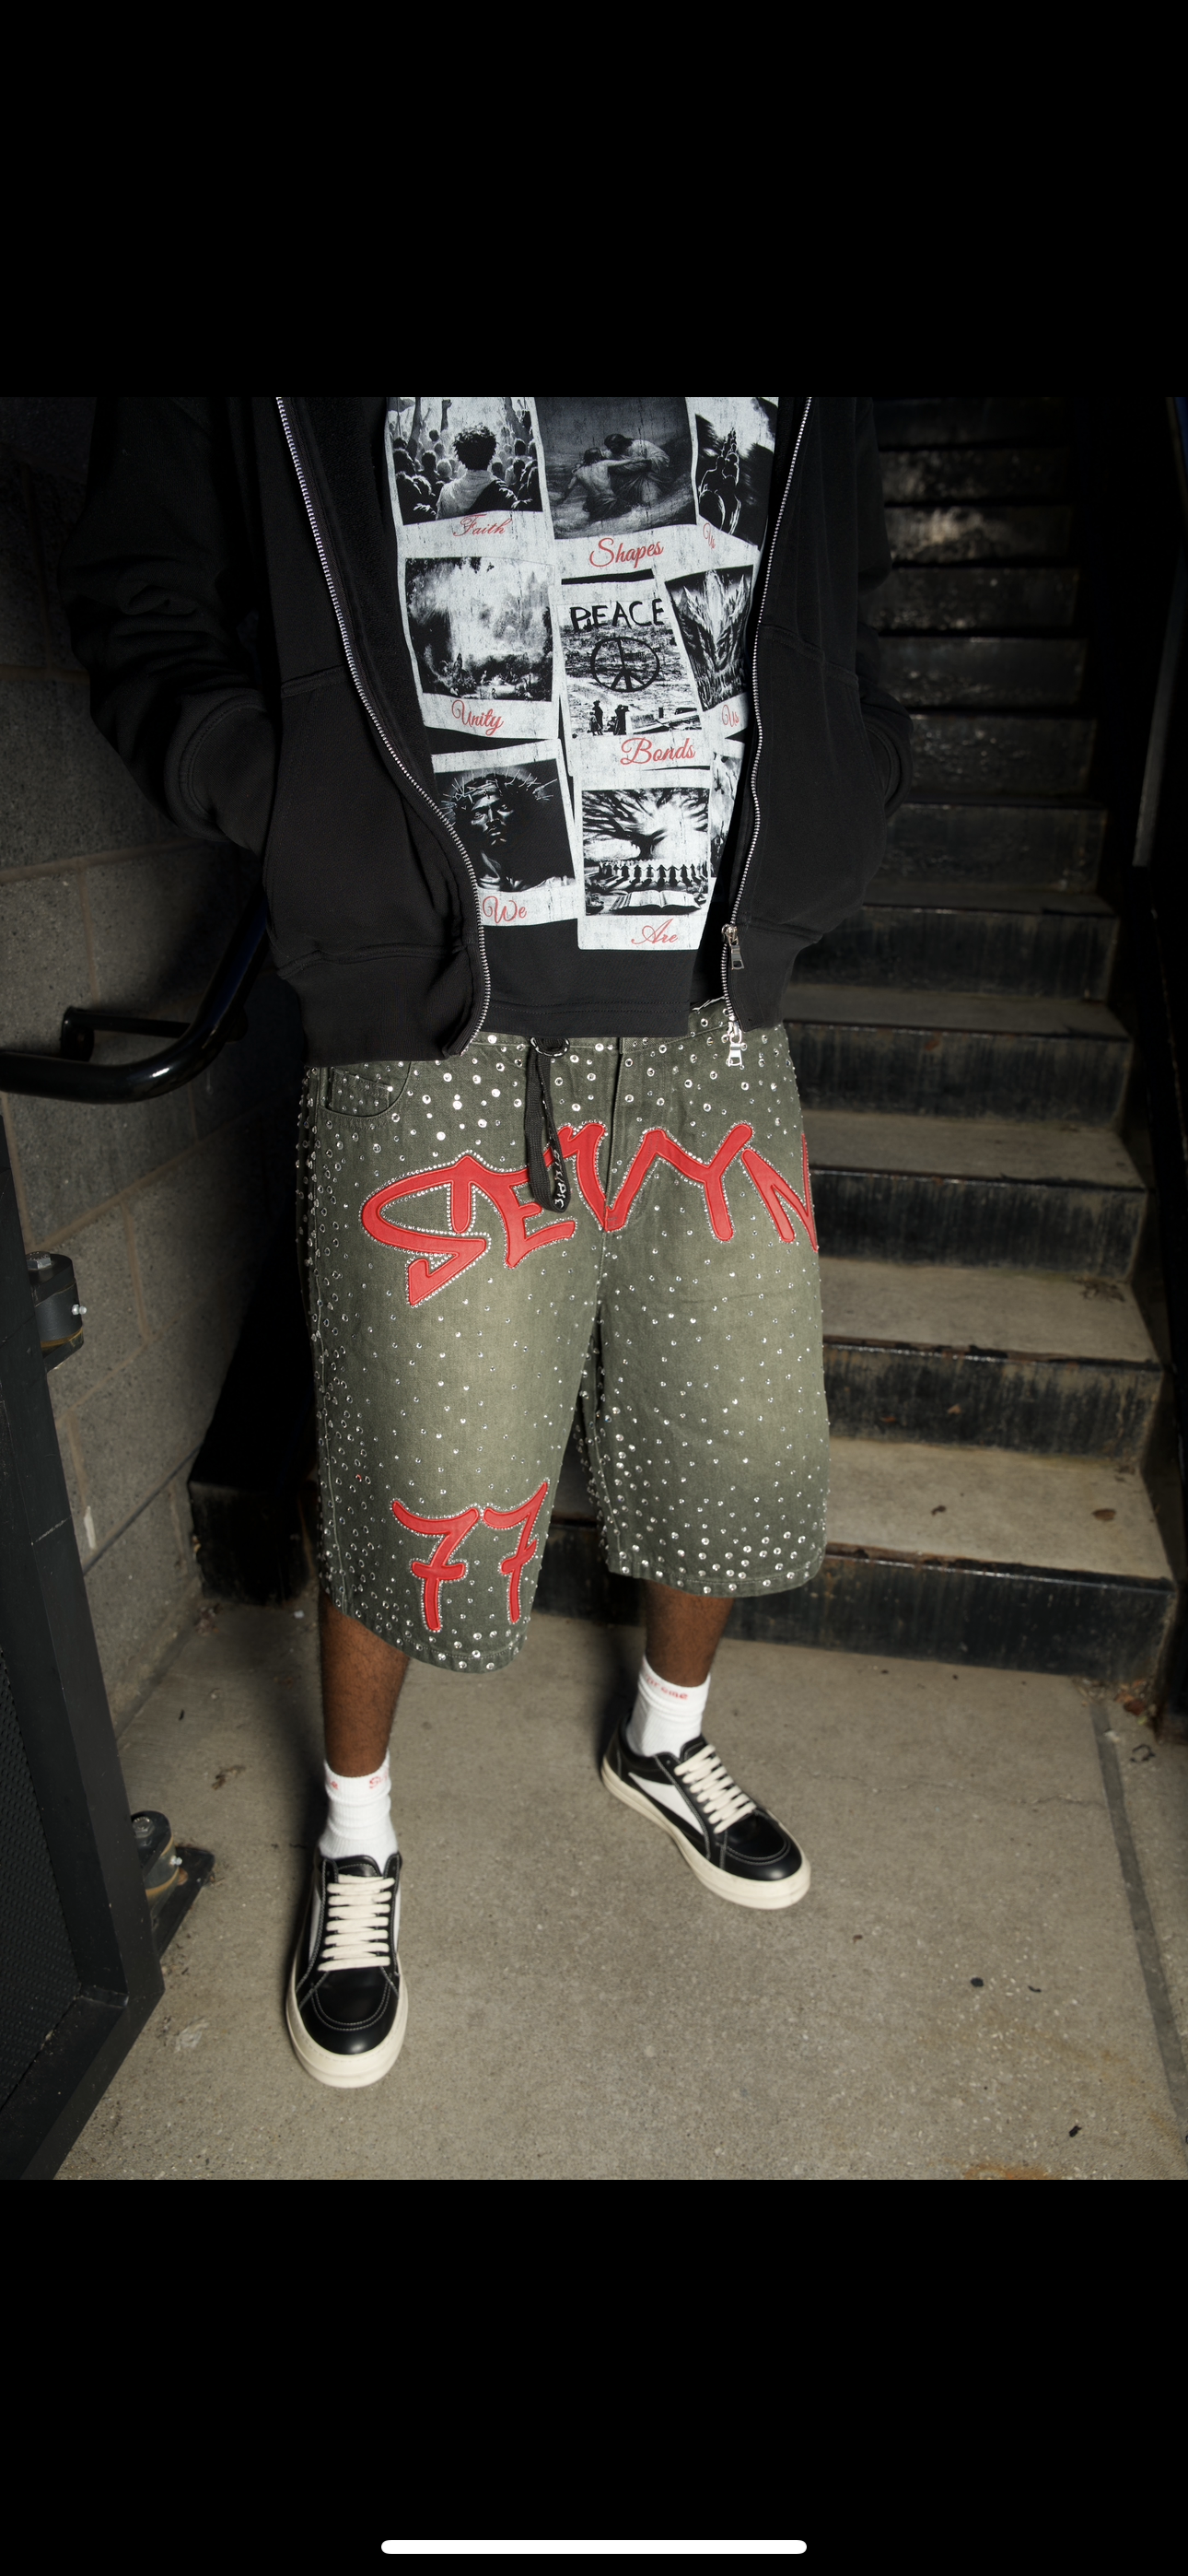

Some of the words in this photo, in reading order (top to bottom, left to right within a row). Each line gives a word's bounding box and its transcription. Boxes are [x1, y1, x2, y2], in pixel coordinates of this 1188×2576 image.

[452, 512, 512, 537] Faith
[588, 537, 664, 568] Shapes
[569, 597, 665, 631] PEACE
[450, 699, 505, 737] Unity
[620, 737, 696, 767] Bonds
[482, 896, 528, 925] We
[630, 919, 679, 945] Are
[390, 1481, 550, 1632] 77
